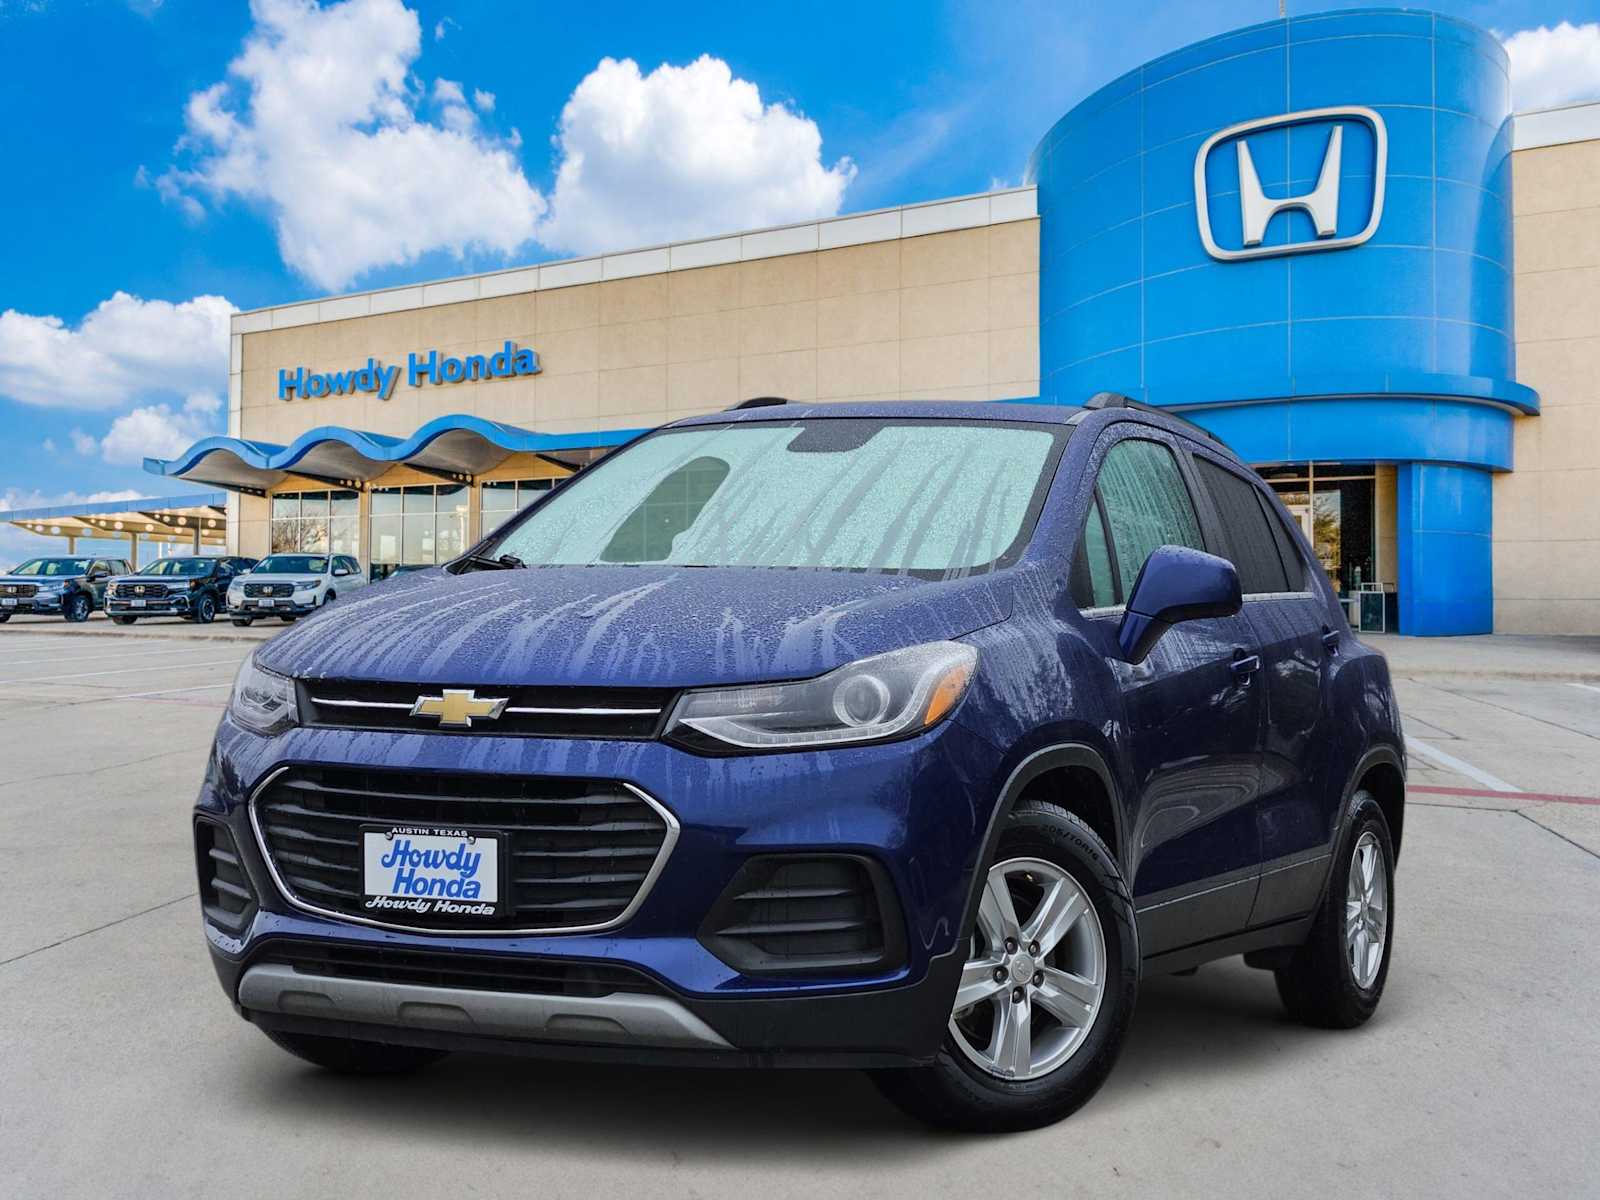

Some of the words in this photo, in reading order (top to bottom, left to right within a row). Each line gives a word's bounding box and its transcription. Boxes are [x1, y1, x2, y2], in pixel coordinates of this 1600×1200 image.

[278, 358, 400, 401] Howdy
[407, 340, 542, 388] Honda
[391, 827, 429, 836] AUSTIN
[433, 829, 469, 837] TEXAS
[381, 839, 482, 878] Howdy
[392, 868, 482, 899] Honda
[365, 896, 431, 914] Howdy
[433, 900, 496, 916] Honda
